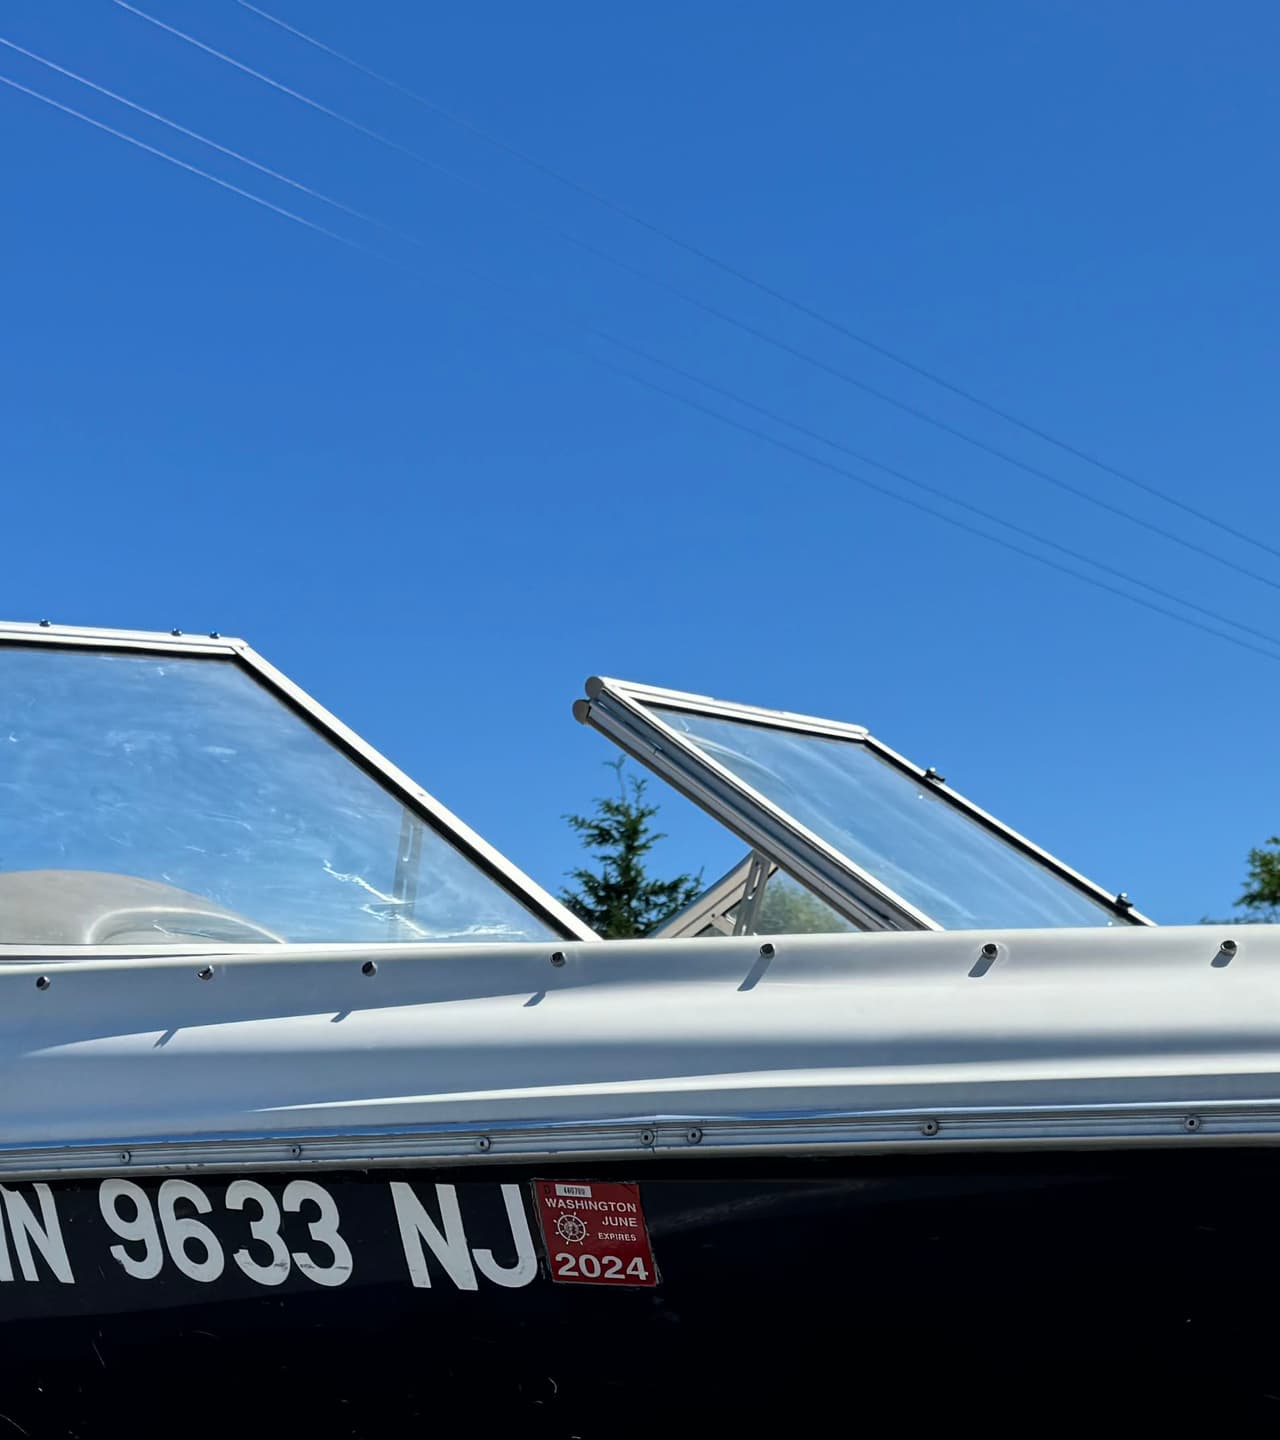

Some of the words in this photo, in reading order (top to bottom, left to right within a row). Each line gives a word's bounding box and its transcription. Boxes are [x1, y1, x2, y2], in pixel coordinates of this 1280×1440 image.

[545, 1198, 637, 1213] WASHINGTON
[602, 1216, 638, 1227] JUNE
[98, 1179, 353, 1286] 9633
[389, 1181, 537, 1290] NJ
[598, 1232, 637, 1242] EXPIRES
[555, 1252, 649, 1280] 2024
